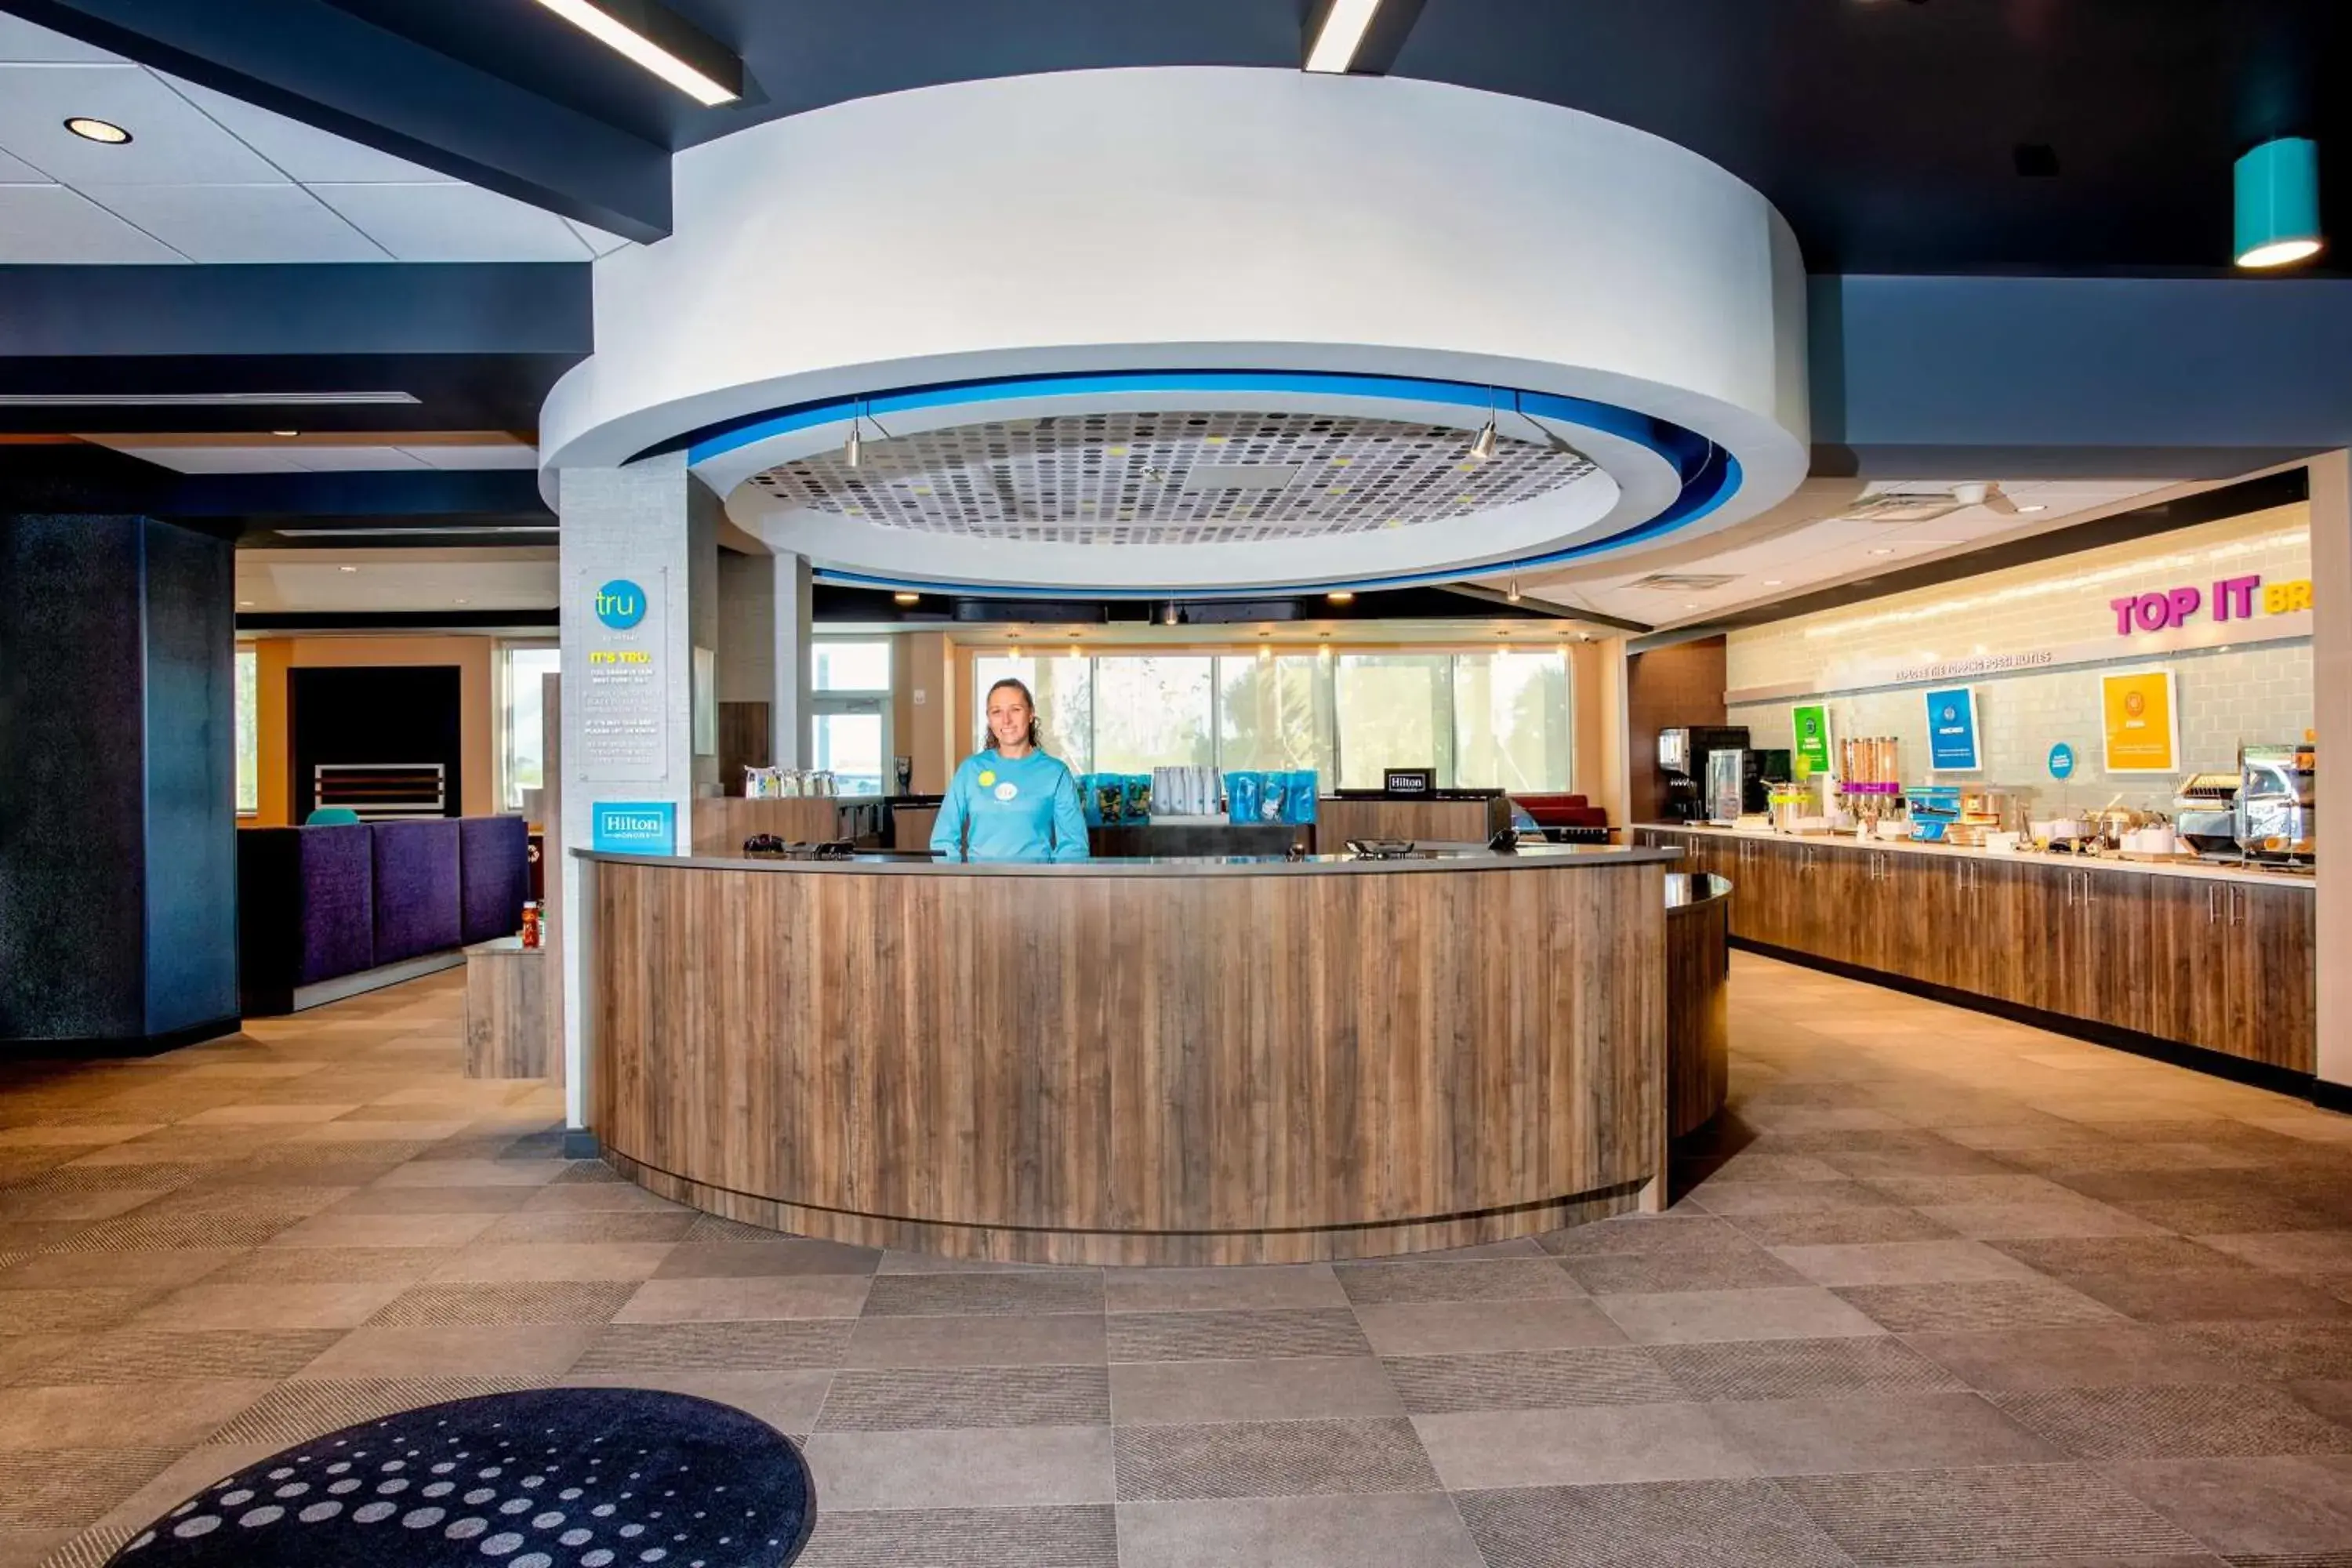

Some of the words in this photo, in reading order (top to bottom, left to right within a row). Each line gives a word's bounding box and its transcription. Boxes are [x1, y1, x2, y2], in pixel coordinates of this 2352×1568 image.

[596, 590, 633, 615] tru
[2110, 586, 2201, 635] TOP
[2212, 575, 2260, 622] IT
[590, 652, 615, 664] IT'S
[1392, 777, 1422, 787] Hilton
[608, 816, 658, 830] Hilton
